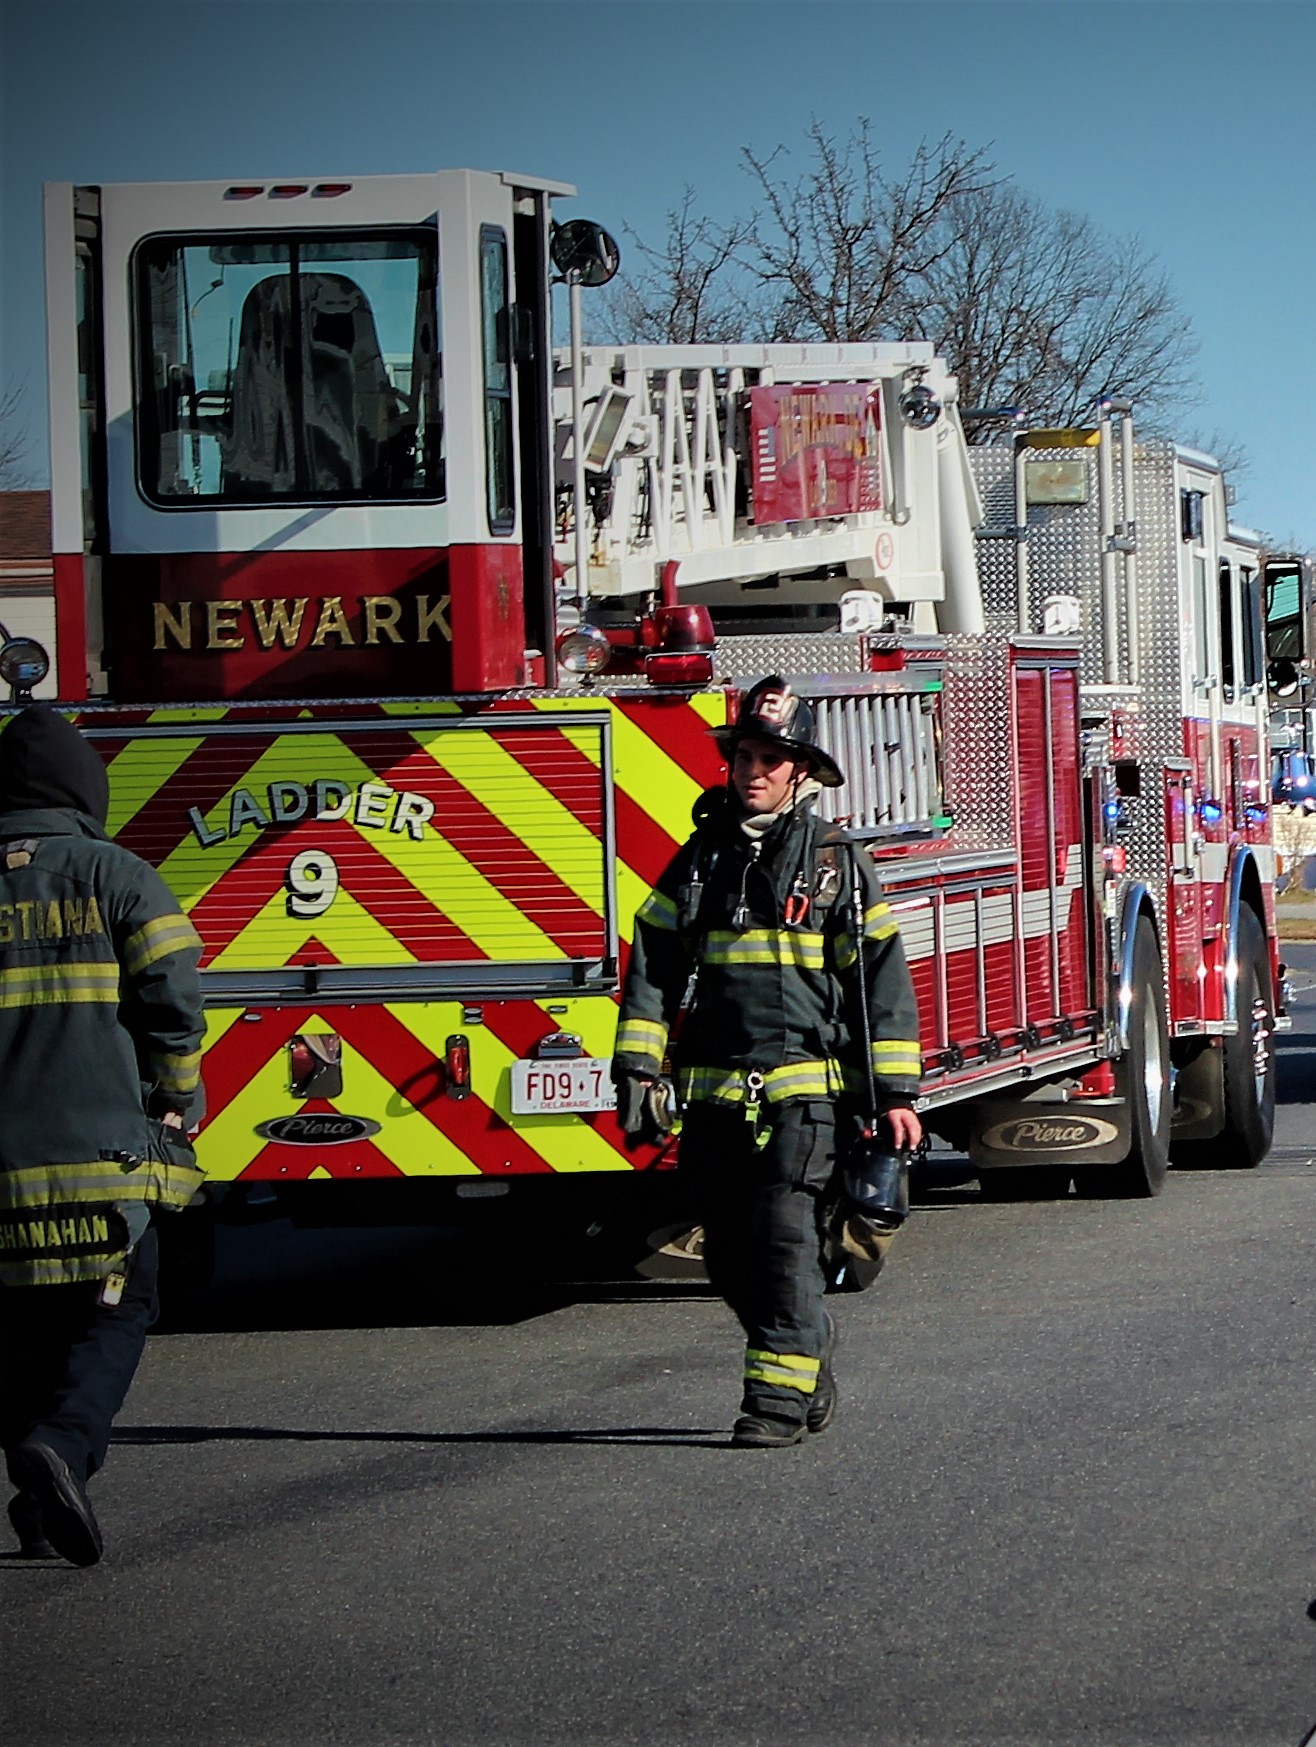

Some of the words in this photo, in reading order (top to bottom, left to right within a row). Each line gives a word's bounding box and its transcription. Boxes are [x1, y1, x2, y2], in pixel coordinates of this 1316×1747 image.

[152, 595, 453, 650] NEWARK
[187, 779, 436, 849] LADDER
[286, 848, 340, 920] 9
[540, 1100, 590, 1109] DELAWARE
[280, 1119, 355, 1138] Pierce
[1011, 1121, 1087, 1146] Pierce
